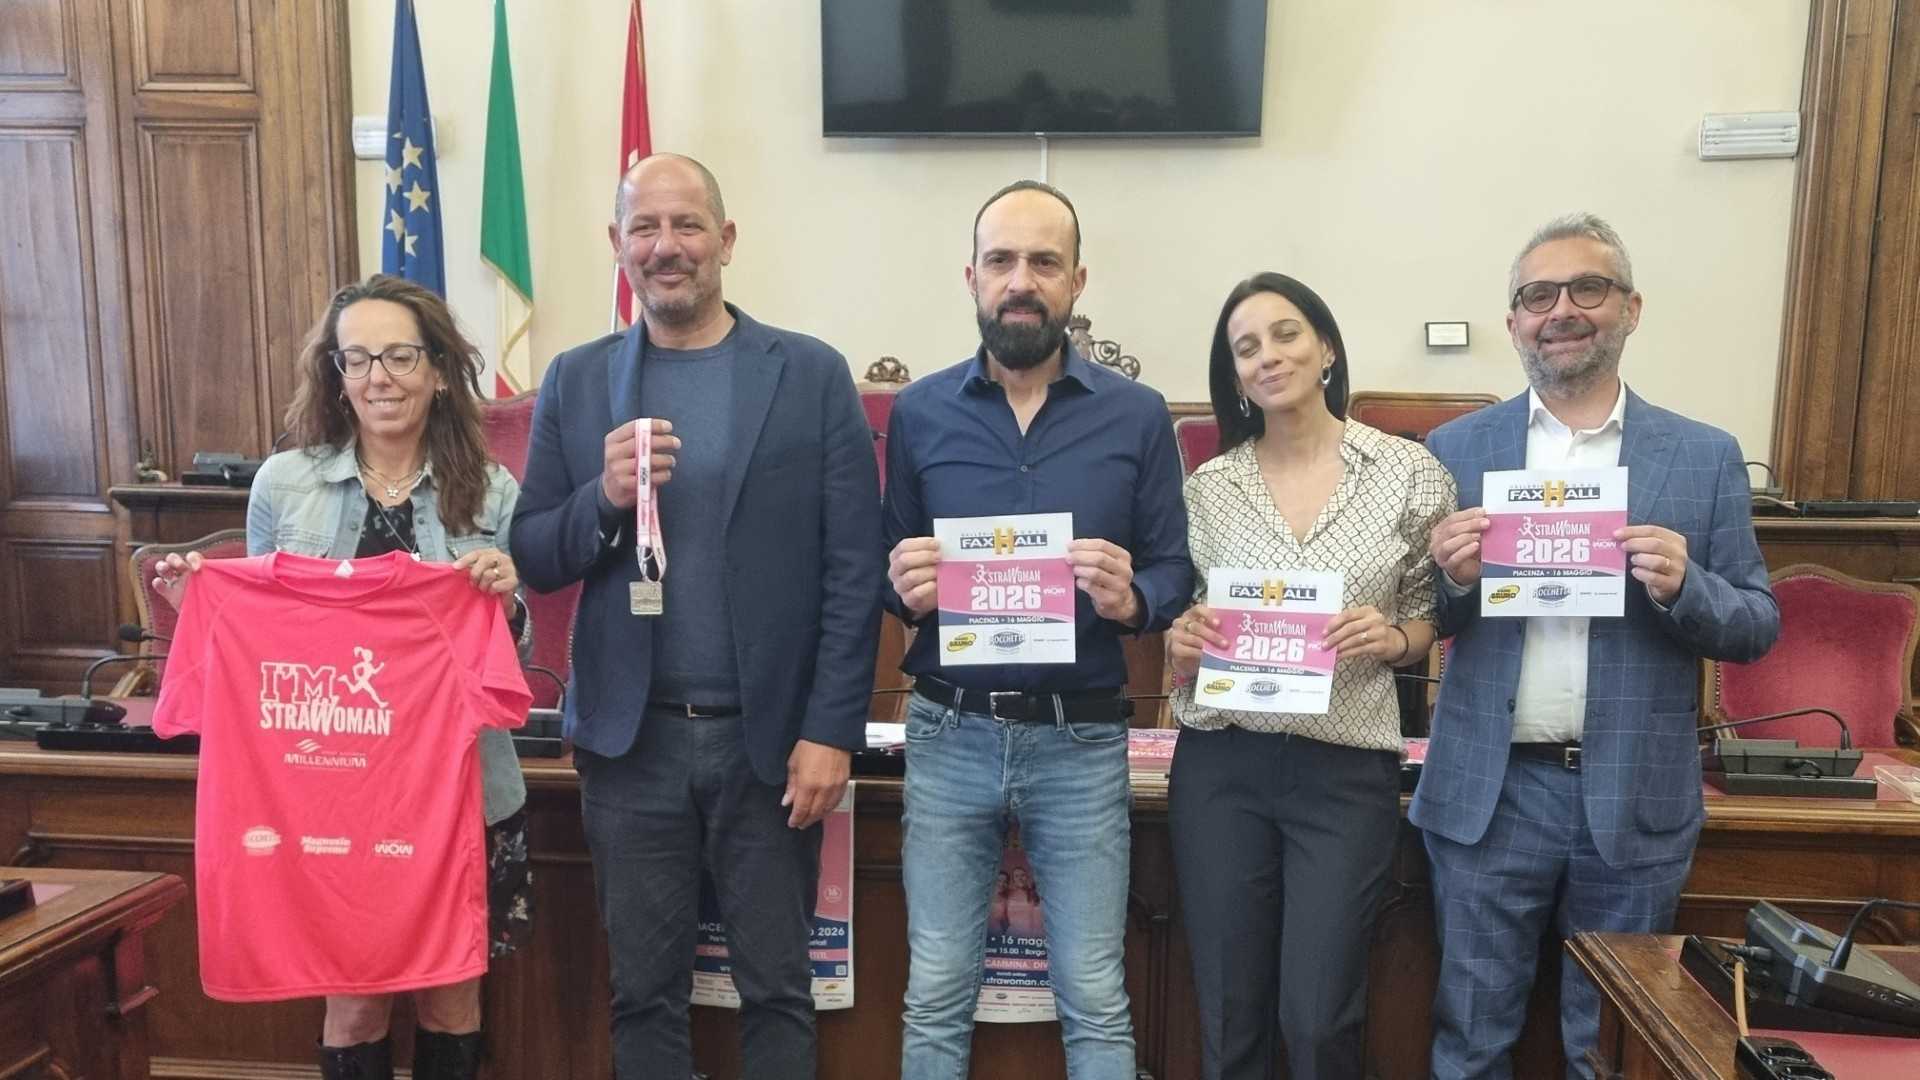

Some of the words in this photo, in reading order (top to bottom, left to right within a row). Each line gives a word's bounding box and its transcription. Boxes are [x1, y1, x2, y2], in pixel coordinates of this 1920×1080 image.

[1509, 480, 1600, 507] FAXHALL
[961, 528, 1047, 554] FAXHALL
[1516, 538, 1591, 563] 2026
[1563, 568, 1593, 576] MAGGIO
[971, 585, 1042, 610] 2026
[1230, 579, 1317, 606] FAXHALL
[969, 617, 999, 625] PIACENZA
[1235, 634, 1305, 662] 2026
[817, 927, 845, 937] 2026
[1001, 935, 1014, 945] 16
